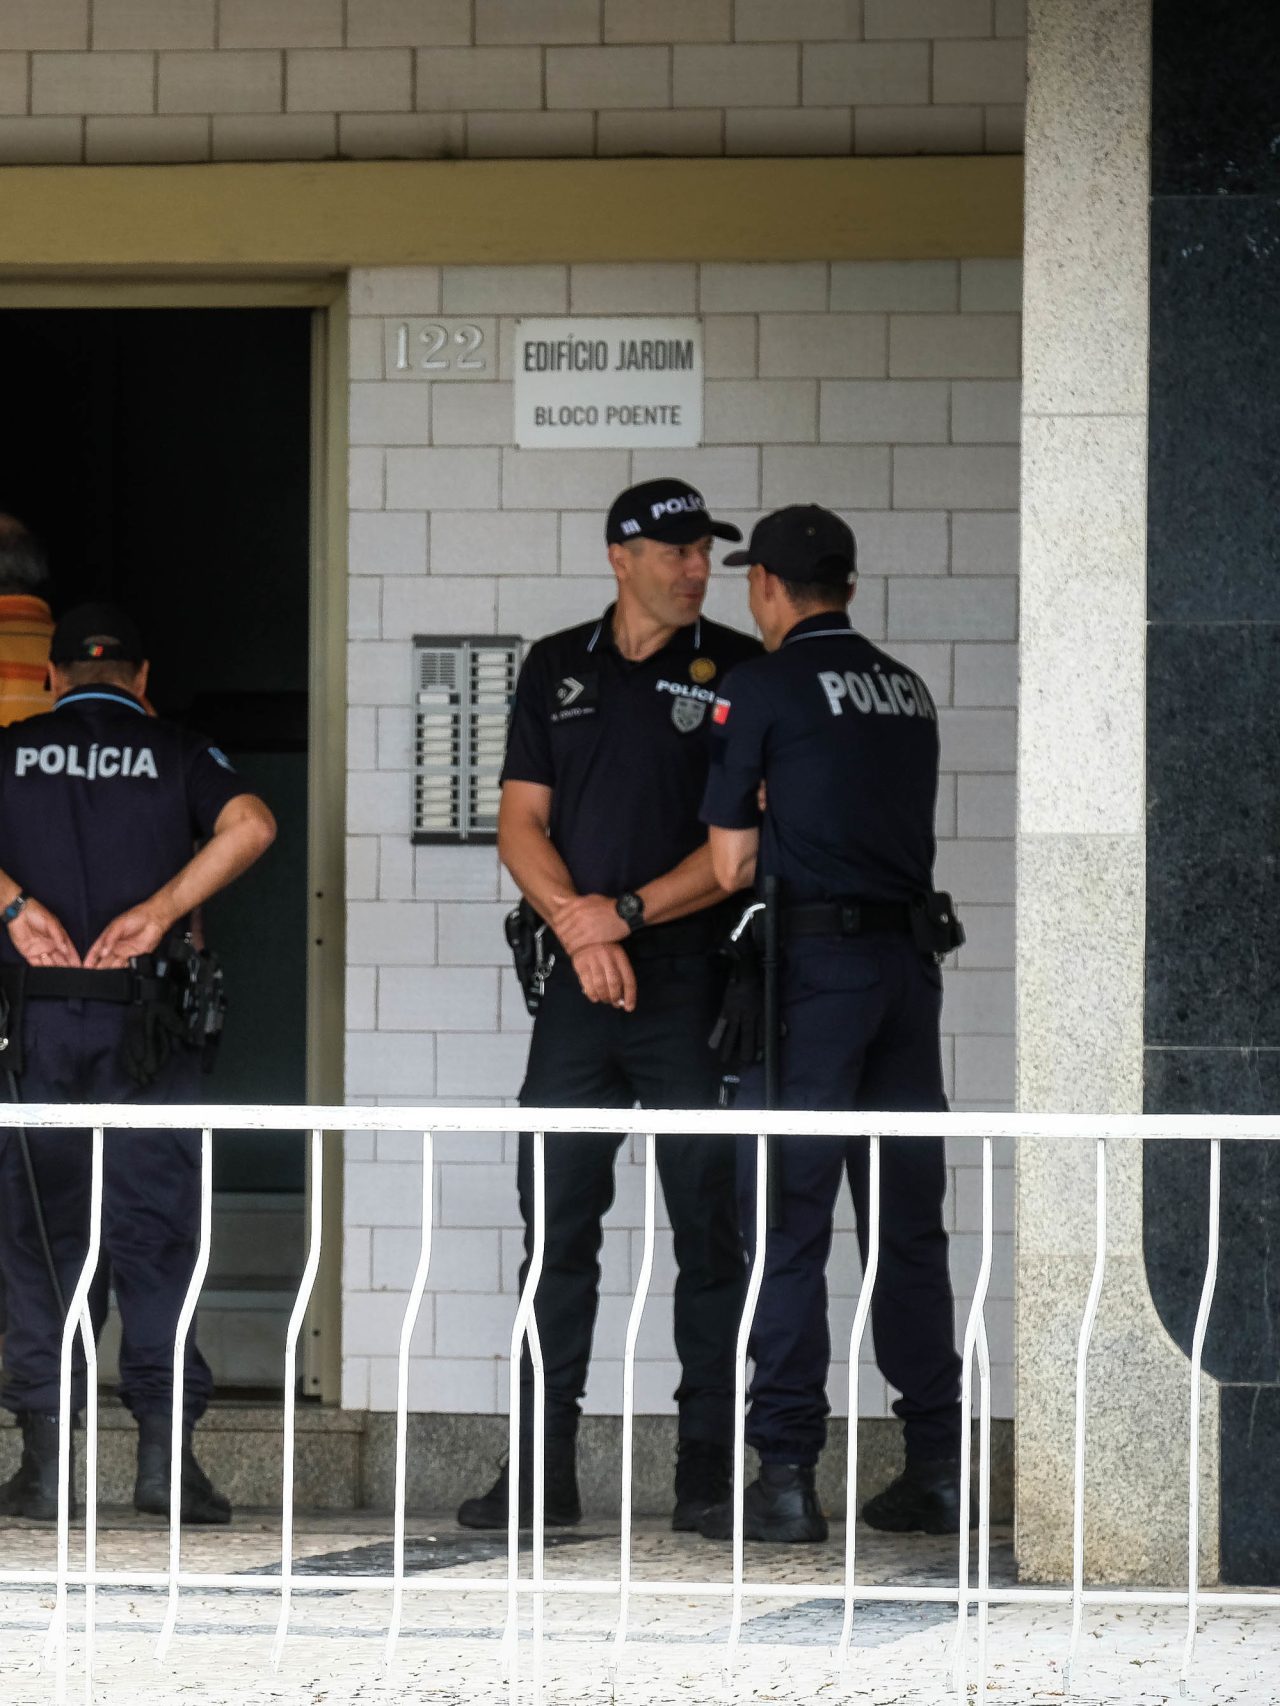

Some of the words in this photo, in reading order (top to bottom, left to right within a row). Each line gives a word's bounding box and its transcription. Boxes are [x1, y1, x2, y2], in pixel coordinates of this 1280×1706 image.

[395, 322, 487, 370] 122
[523, 333, 609, 372] EDIFÍCIO
[615, 339, 695, 371] JARDIM
[534, 405, 599, 426] BLOCO
[606, 404, 682, 426] POENTE
[655, 679, 716, 704] POLÍCI
[15, 743, 159, 781] POLÍCIA
